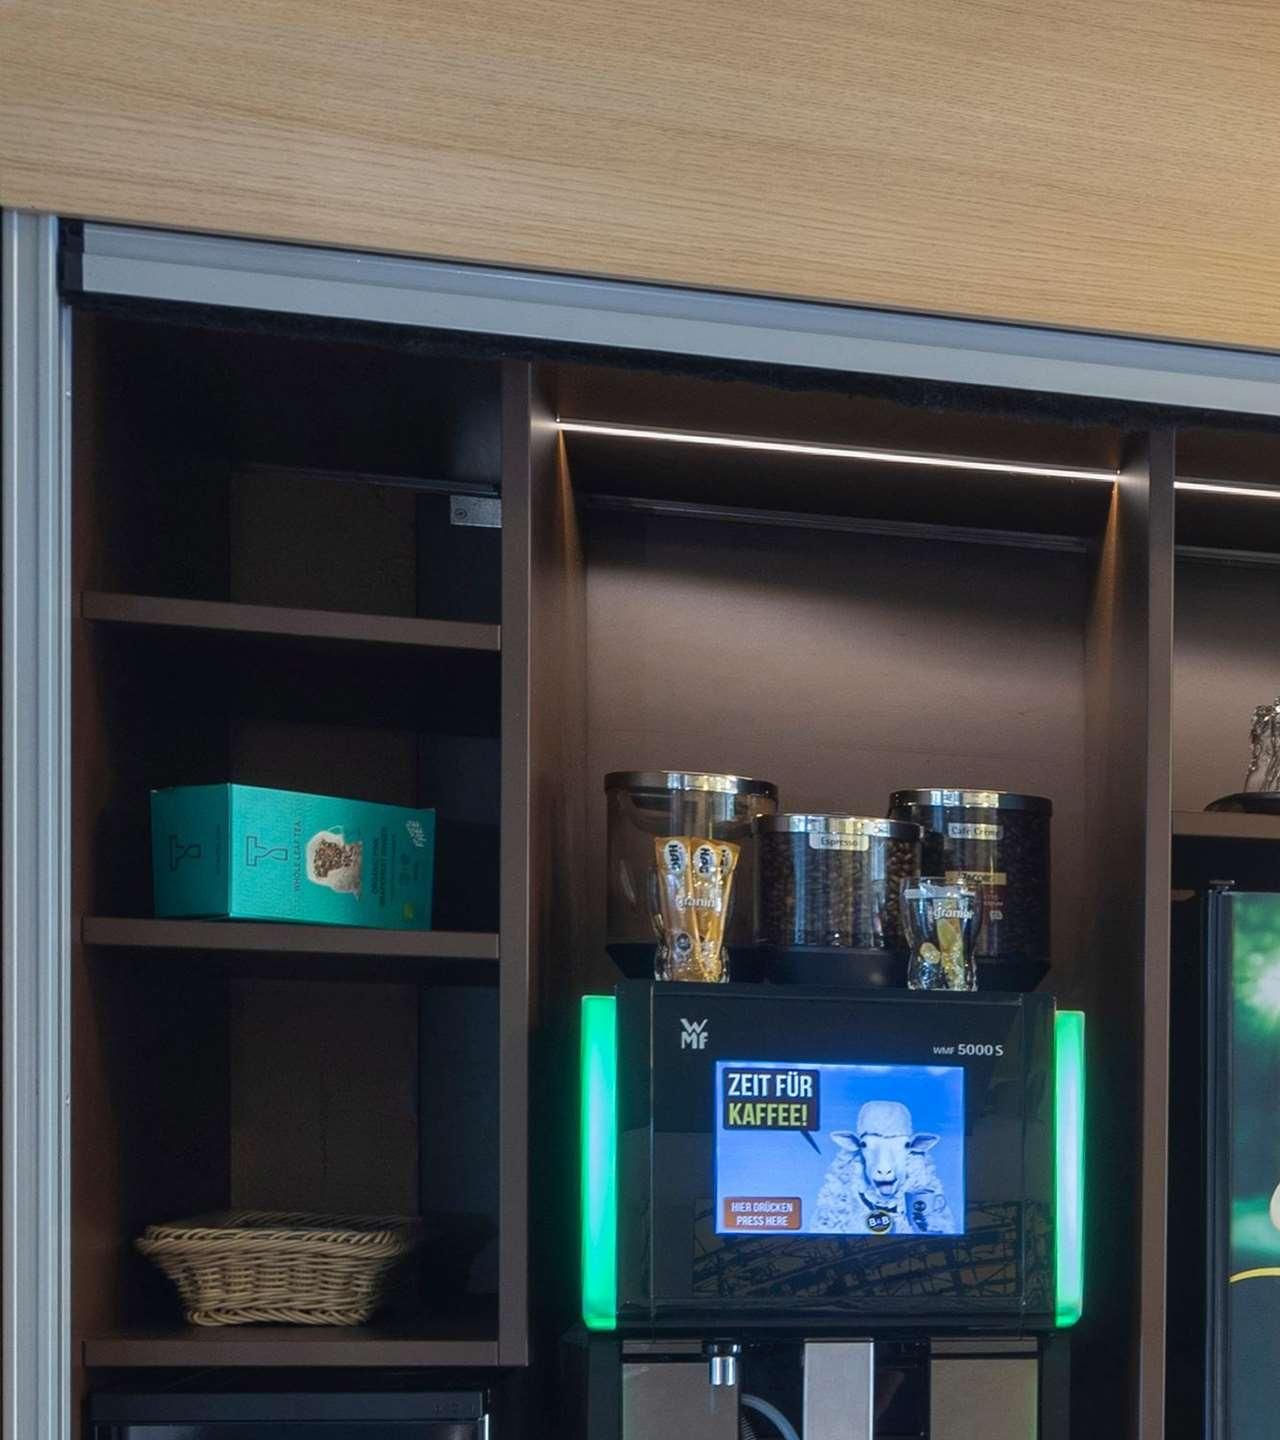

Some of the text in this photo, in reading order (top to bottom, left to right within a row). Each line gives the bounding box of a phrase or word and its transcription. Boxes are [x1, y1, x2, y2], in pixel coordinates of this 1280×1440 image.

[728, 1071, 813, 1098] ZEIT FÜR
[728, 1102, 808, 1127] KAFFEE!
[731, 1201, 793, 1213] HIER DRÜCKEN
[736, 1215, 788, 1227] PRESS HERE
